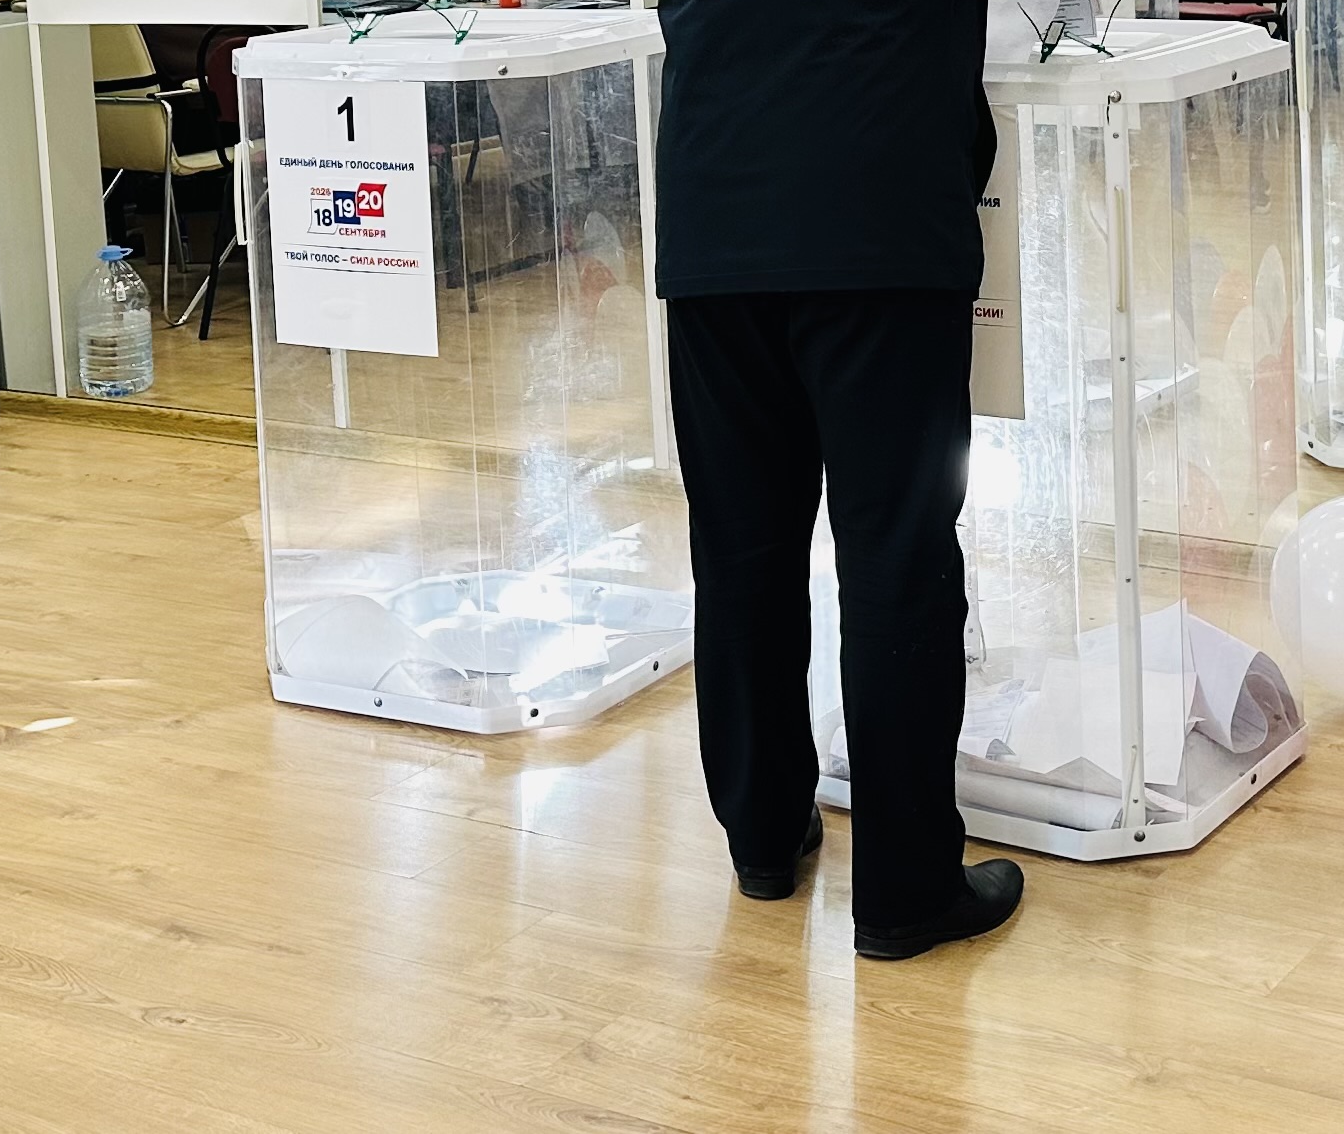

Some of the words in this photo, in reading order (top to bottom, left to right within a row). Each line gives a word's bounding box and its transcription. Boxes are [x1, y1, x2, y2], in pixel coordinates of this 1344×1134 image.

[337, 96, 356, 142] 1
[279, 156, 317, 168] ЕДИНЫЙ
[318, 159, 343, 170] ДЕНЬ
[345, 160, 415, 172] ГОЛОСОВАНИЯ
[313, 208, 333, 227] 18
[335, 198, 356, 218] 19
[358, 191, 383, 210] 20
[338, 227, 386, 239] СЕНТЯБРЯ
[285, 250, 308, 261] ТВОЙ
[310, 252, 340, 263] ГОЛОС
[349, 255, 375, 266] СИЛА
[377, 257, 420, 268] РОССИИ!
[974, 307, 1003, 319] СИИ!
